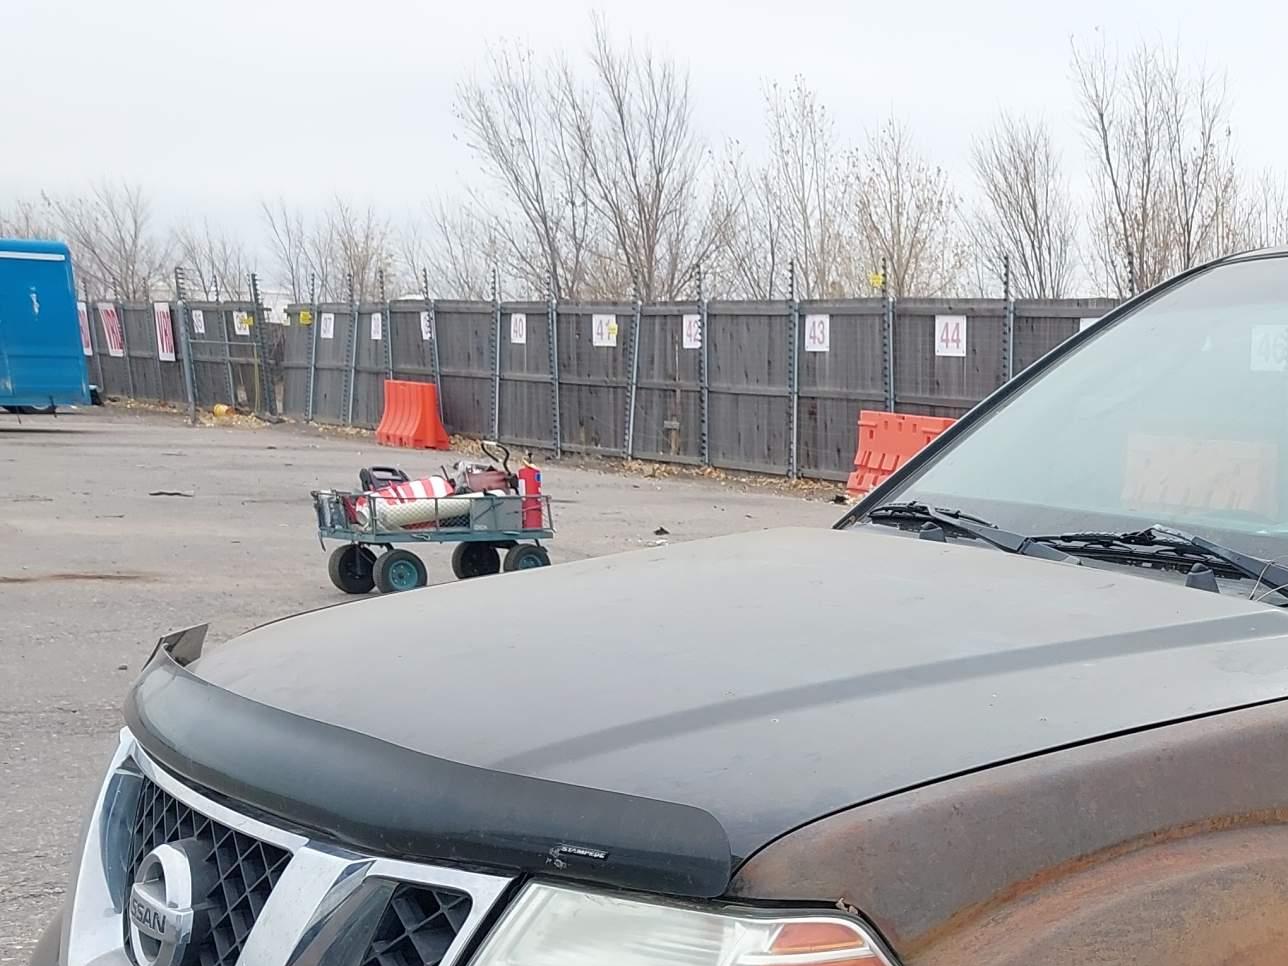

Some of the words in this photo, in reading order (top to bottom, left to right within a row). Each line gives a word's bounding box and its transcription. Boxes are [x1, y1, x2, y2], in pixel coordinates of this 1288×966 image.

[513, 314, 524, 339] 40
[686, 319, 702, 343] 42
[808, 320, 826, 345] 43
[939, 321, 962, 349] 44
[130, 899, 167, 934] SSAN
